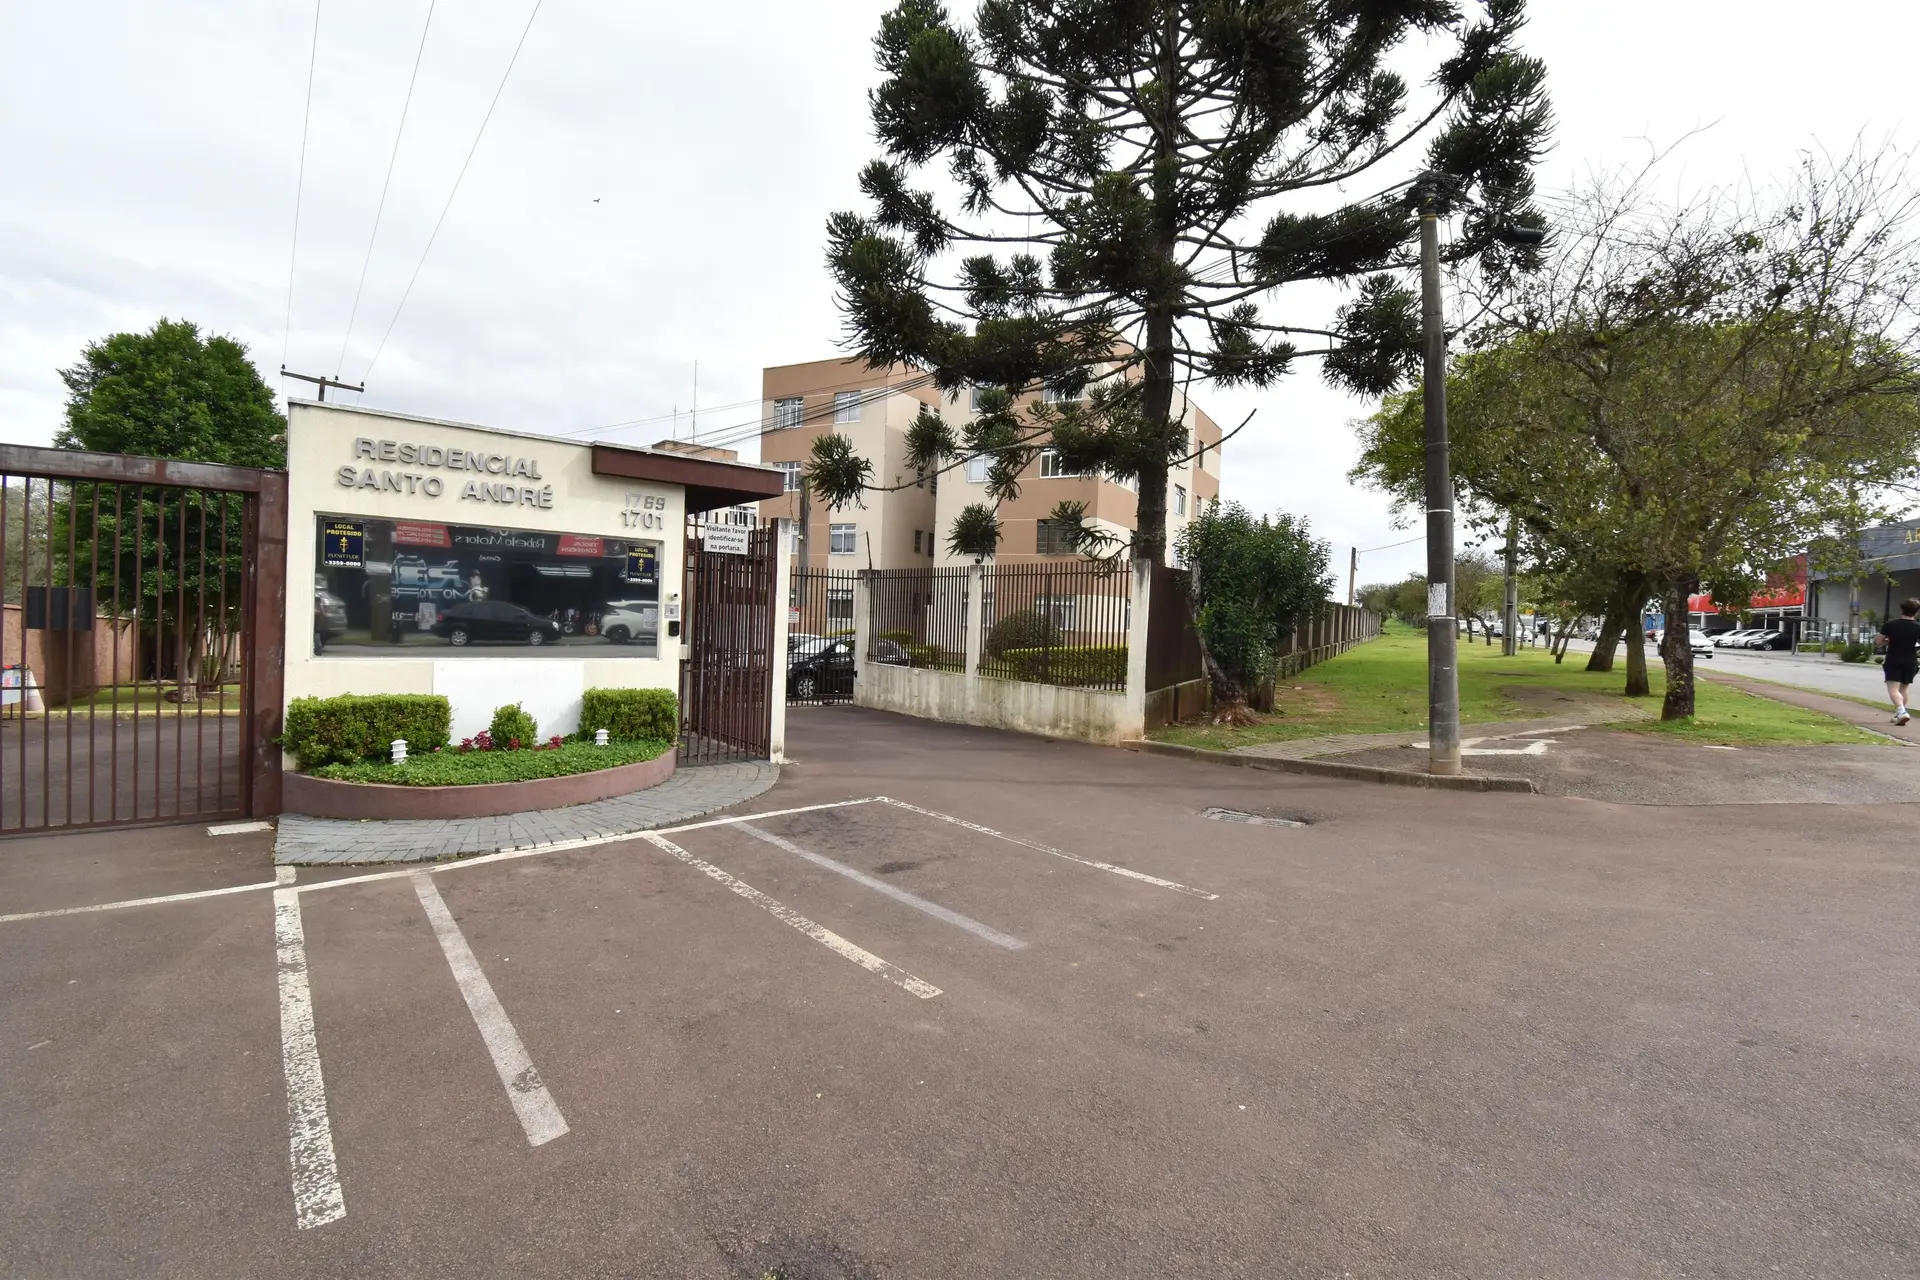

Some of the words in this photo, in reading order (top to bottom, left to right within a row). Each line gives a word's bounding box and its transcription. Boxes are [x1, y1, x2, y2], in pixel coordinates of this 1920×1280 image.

[355, 437, 543, 480] RESIDENCIAL
[337, 464, 445, 497] SANTO
[461, 479, 554, 509] ANDRÉ
[621, 507, 663, 530] 1701
[326, 529, 362, 537] PROTEGIDO
[706, 525, 731, 533] Visitante
[708, 534, 744, 543] identificar-se
